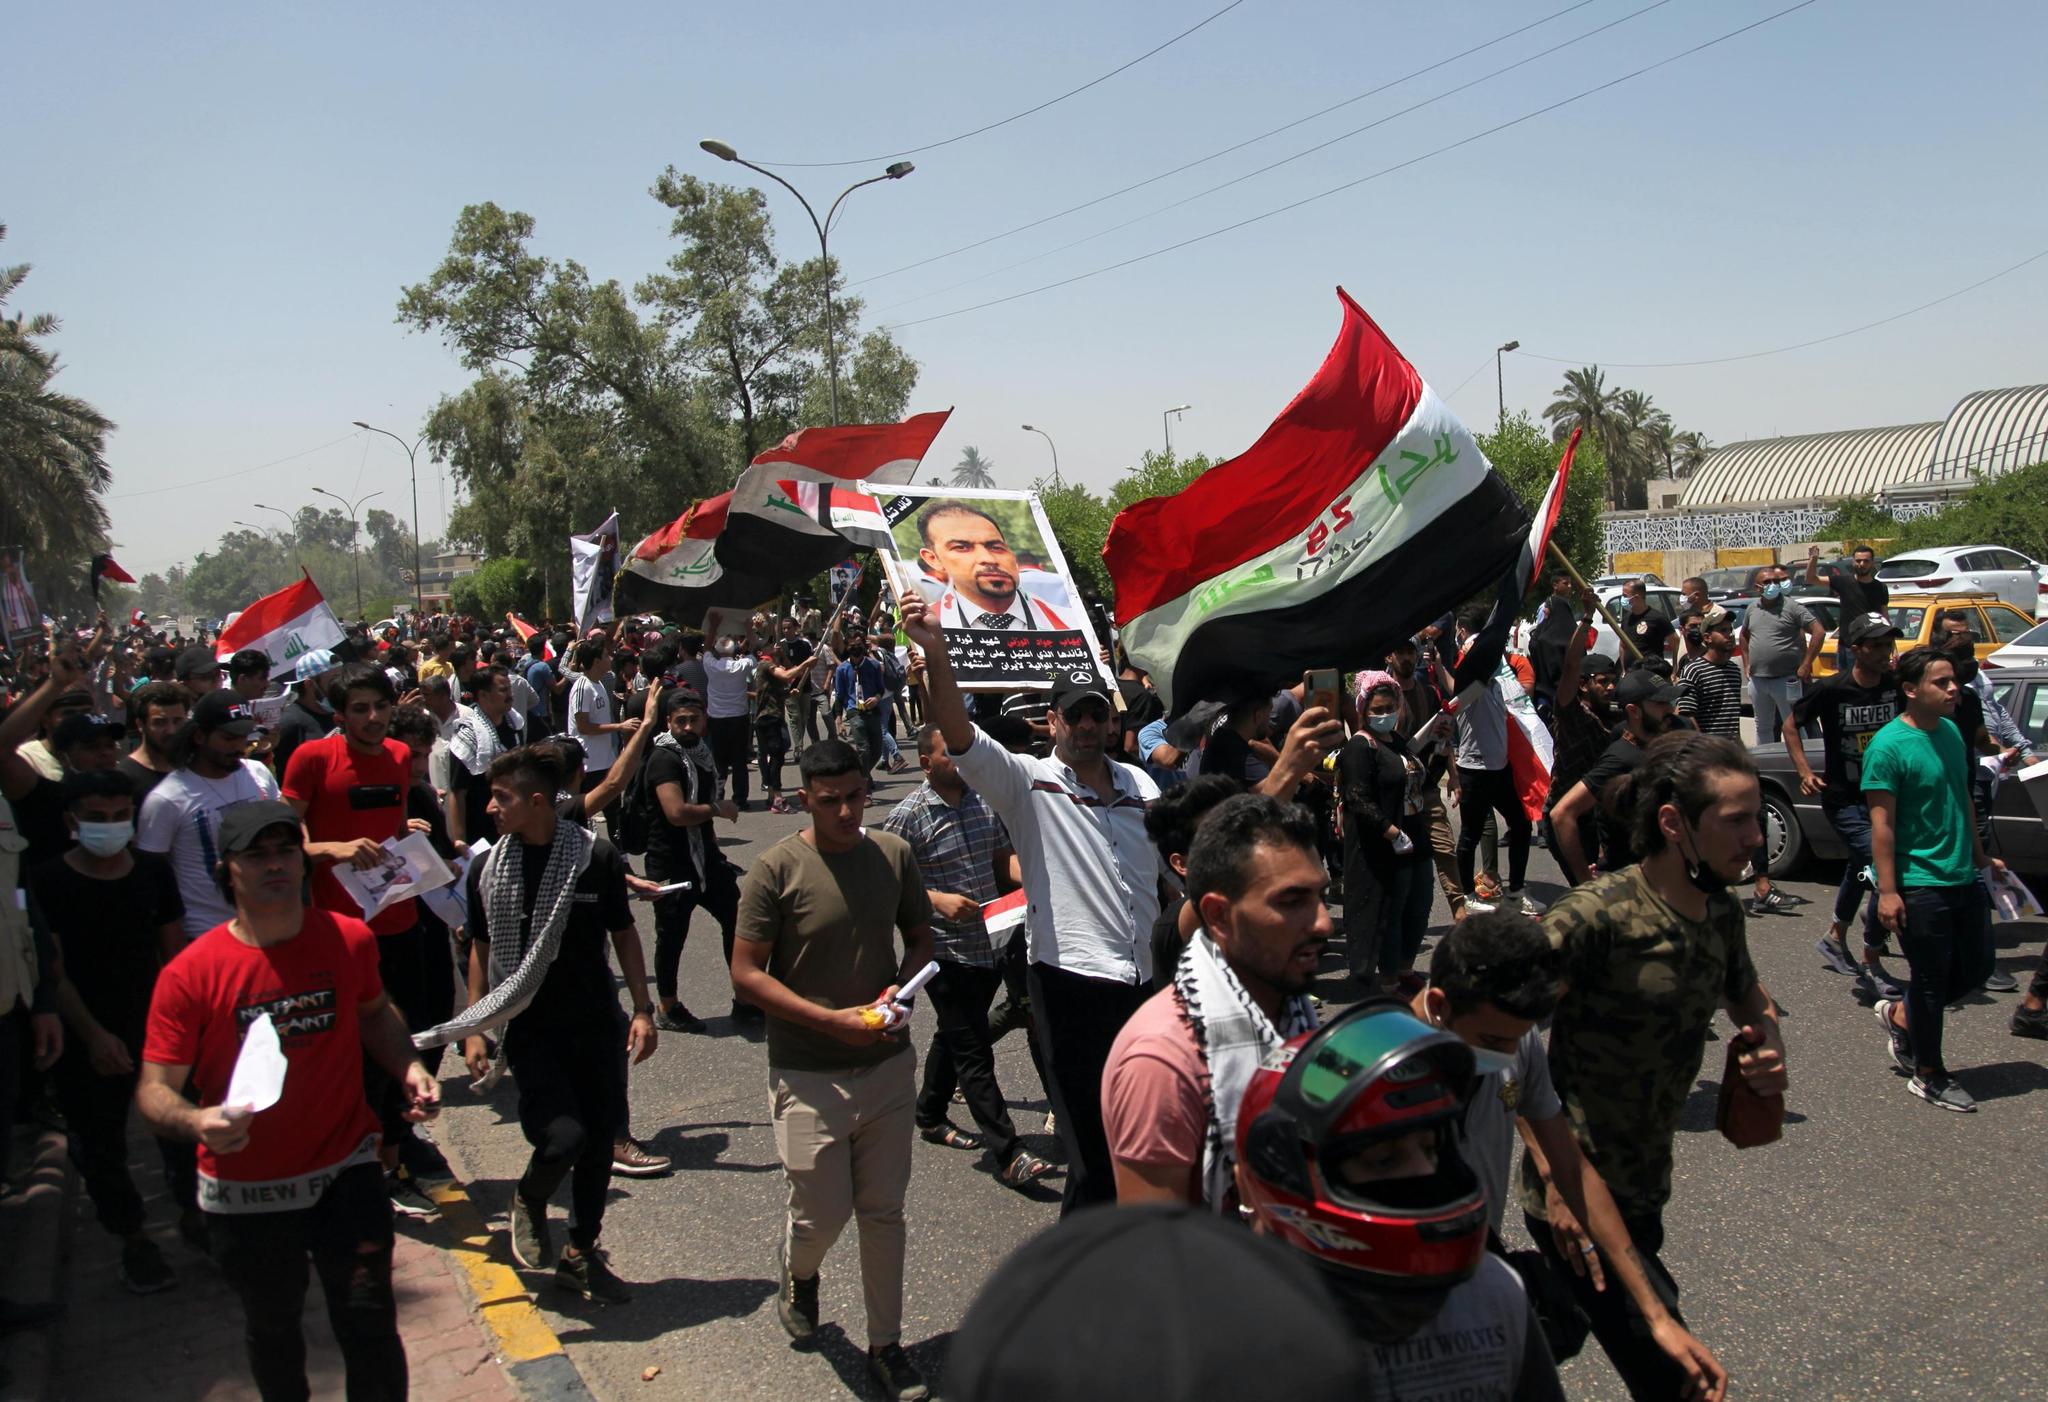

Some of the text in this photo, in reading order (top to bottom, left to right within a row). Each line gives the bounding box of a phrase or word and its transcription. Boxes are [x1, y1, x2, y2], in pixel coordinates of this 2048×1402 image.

[979, 636, 1001, 646] شهيد
[989, 649, 1006, 659] على
[1851, 705, 1891, 724] NEVER
[242, 1182, 297, 1204] NEW
[1374, 1325, 1506, 1369] WITH WOLVES
